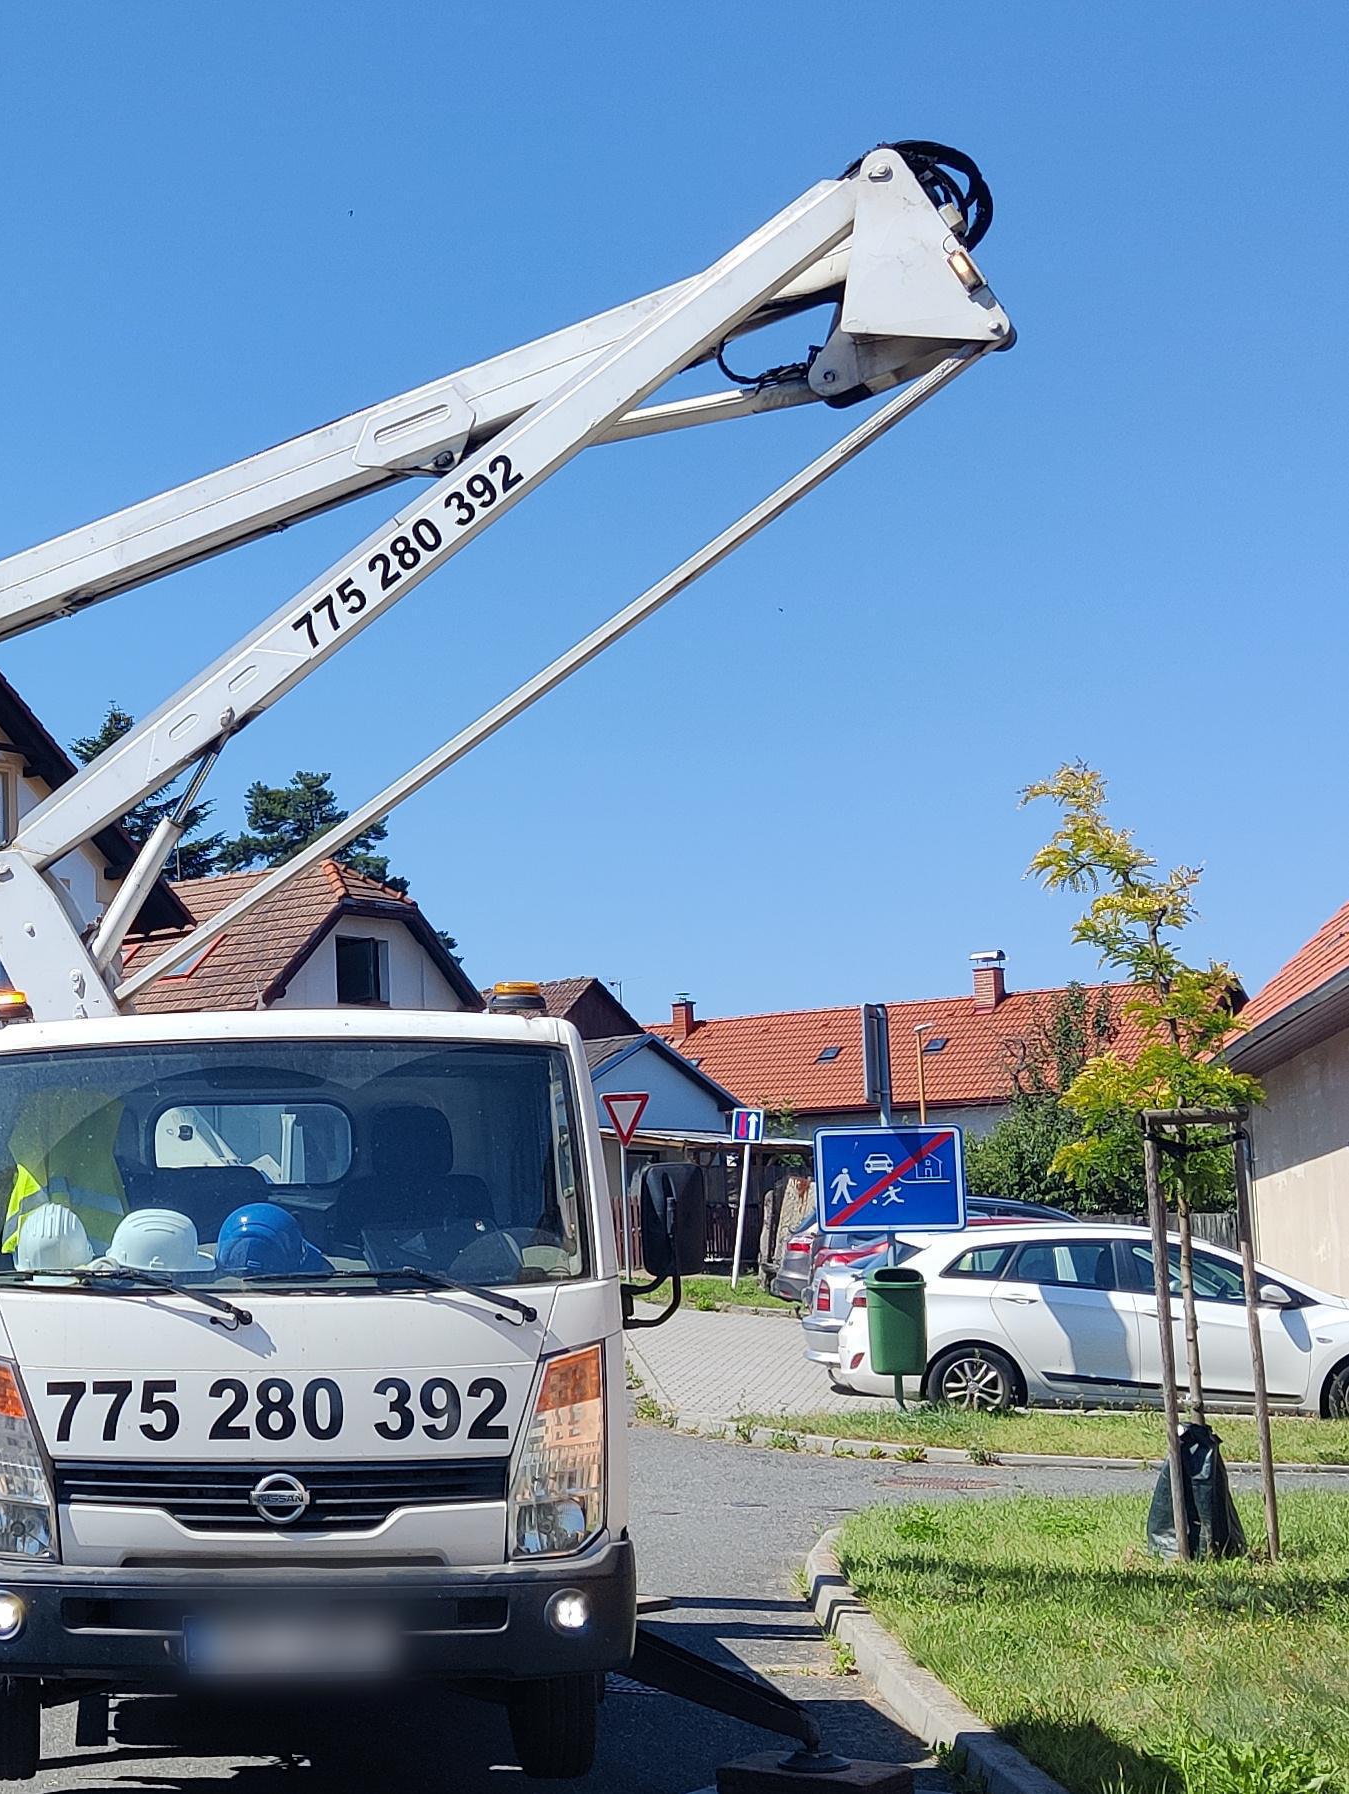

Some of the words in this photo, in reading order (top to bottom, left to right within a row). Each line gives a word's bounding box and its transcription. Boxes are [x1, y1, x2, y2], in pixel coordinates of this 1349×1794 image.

[291, 577, 367, 649] 775
[368, 518, 443, 591] 280
[444, 454, 524, 526] 392
[46, 1379, 180, 1442] 775
[208, 1377, 344, 1441] 280
[373, 1377, 509, 1441] 392
[257, 1493, 305, 1504] NISSAN
